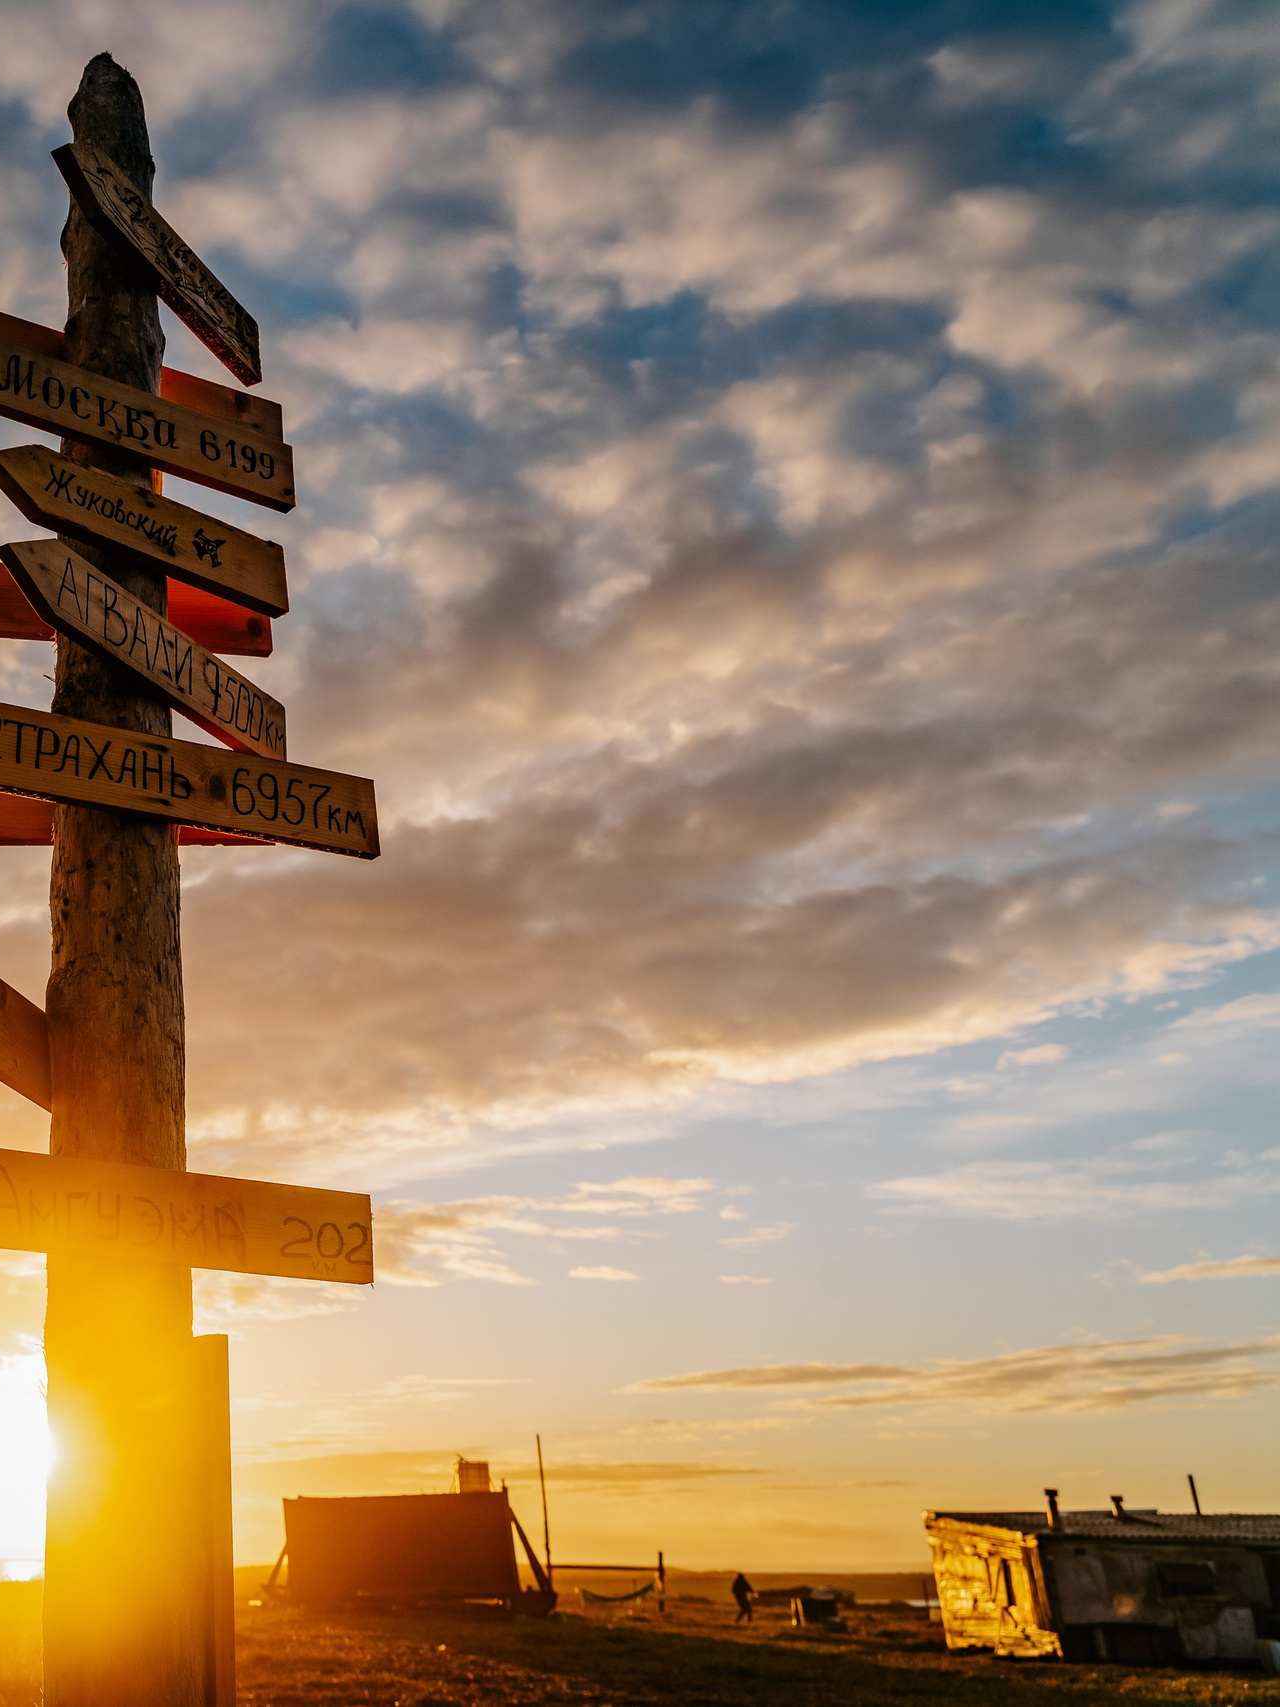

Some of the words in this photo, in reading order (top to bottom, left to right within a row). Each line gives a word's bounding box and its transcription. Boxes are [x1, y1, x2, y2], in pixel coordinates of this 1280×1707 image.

[199, 429, 276, 480] 6199
[44, 463, 178, 556] Жуковский
[57, 556, 193, 696] АГВАЛИ
[280, 1216, 373, 1266] 202
